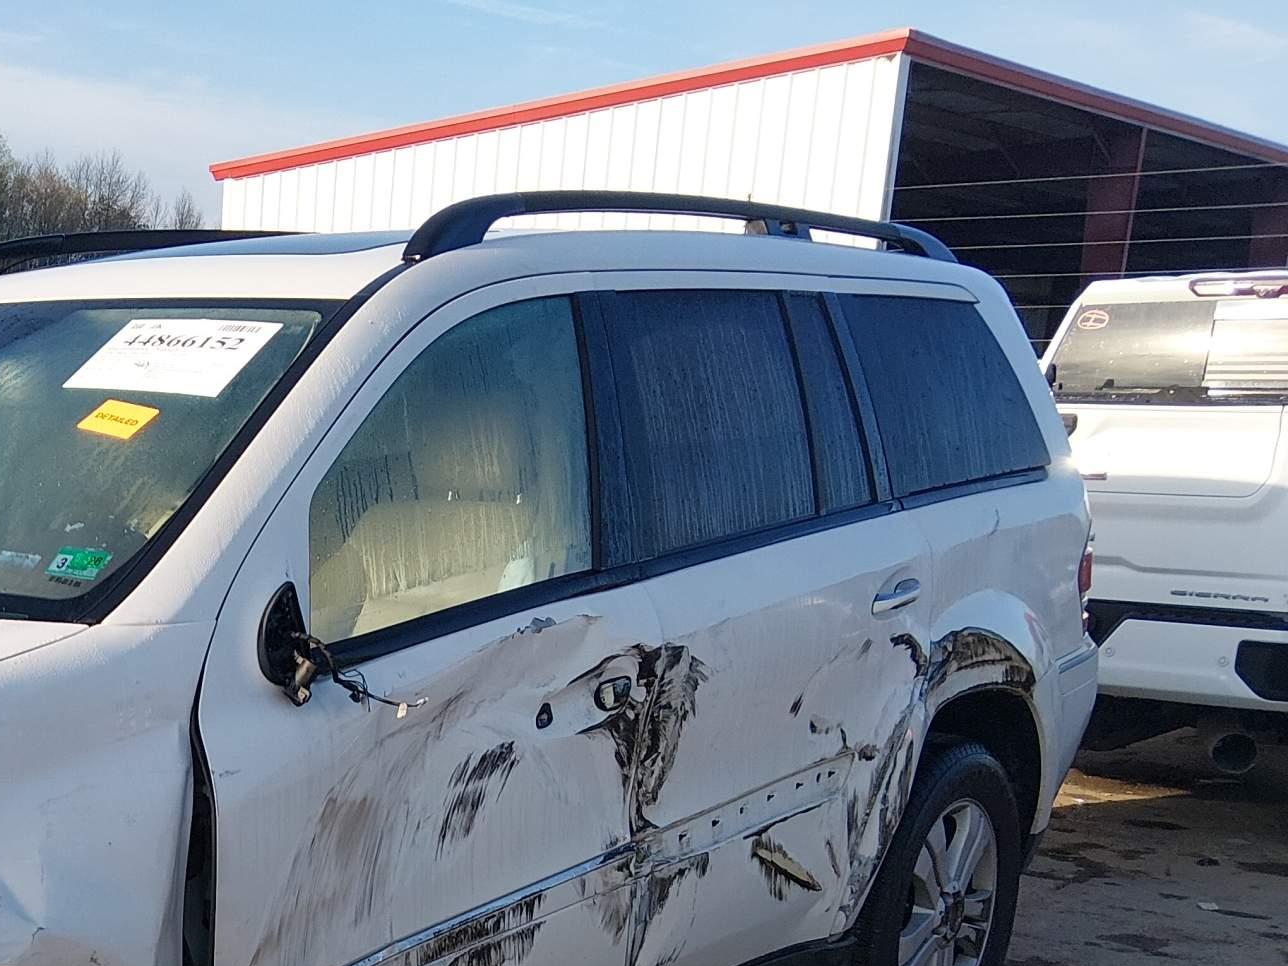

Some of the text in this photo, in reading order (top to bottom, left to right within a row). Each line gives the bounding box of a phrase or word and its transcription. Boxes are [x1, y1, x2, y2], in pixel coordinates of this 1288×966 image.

[123, 334, 246, 351] 44866152
[95, 411, 139, 426] DETAILED
[56, 557, 69, 569] 3
[1170, 590, 1269, 602] SIERRA
